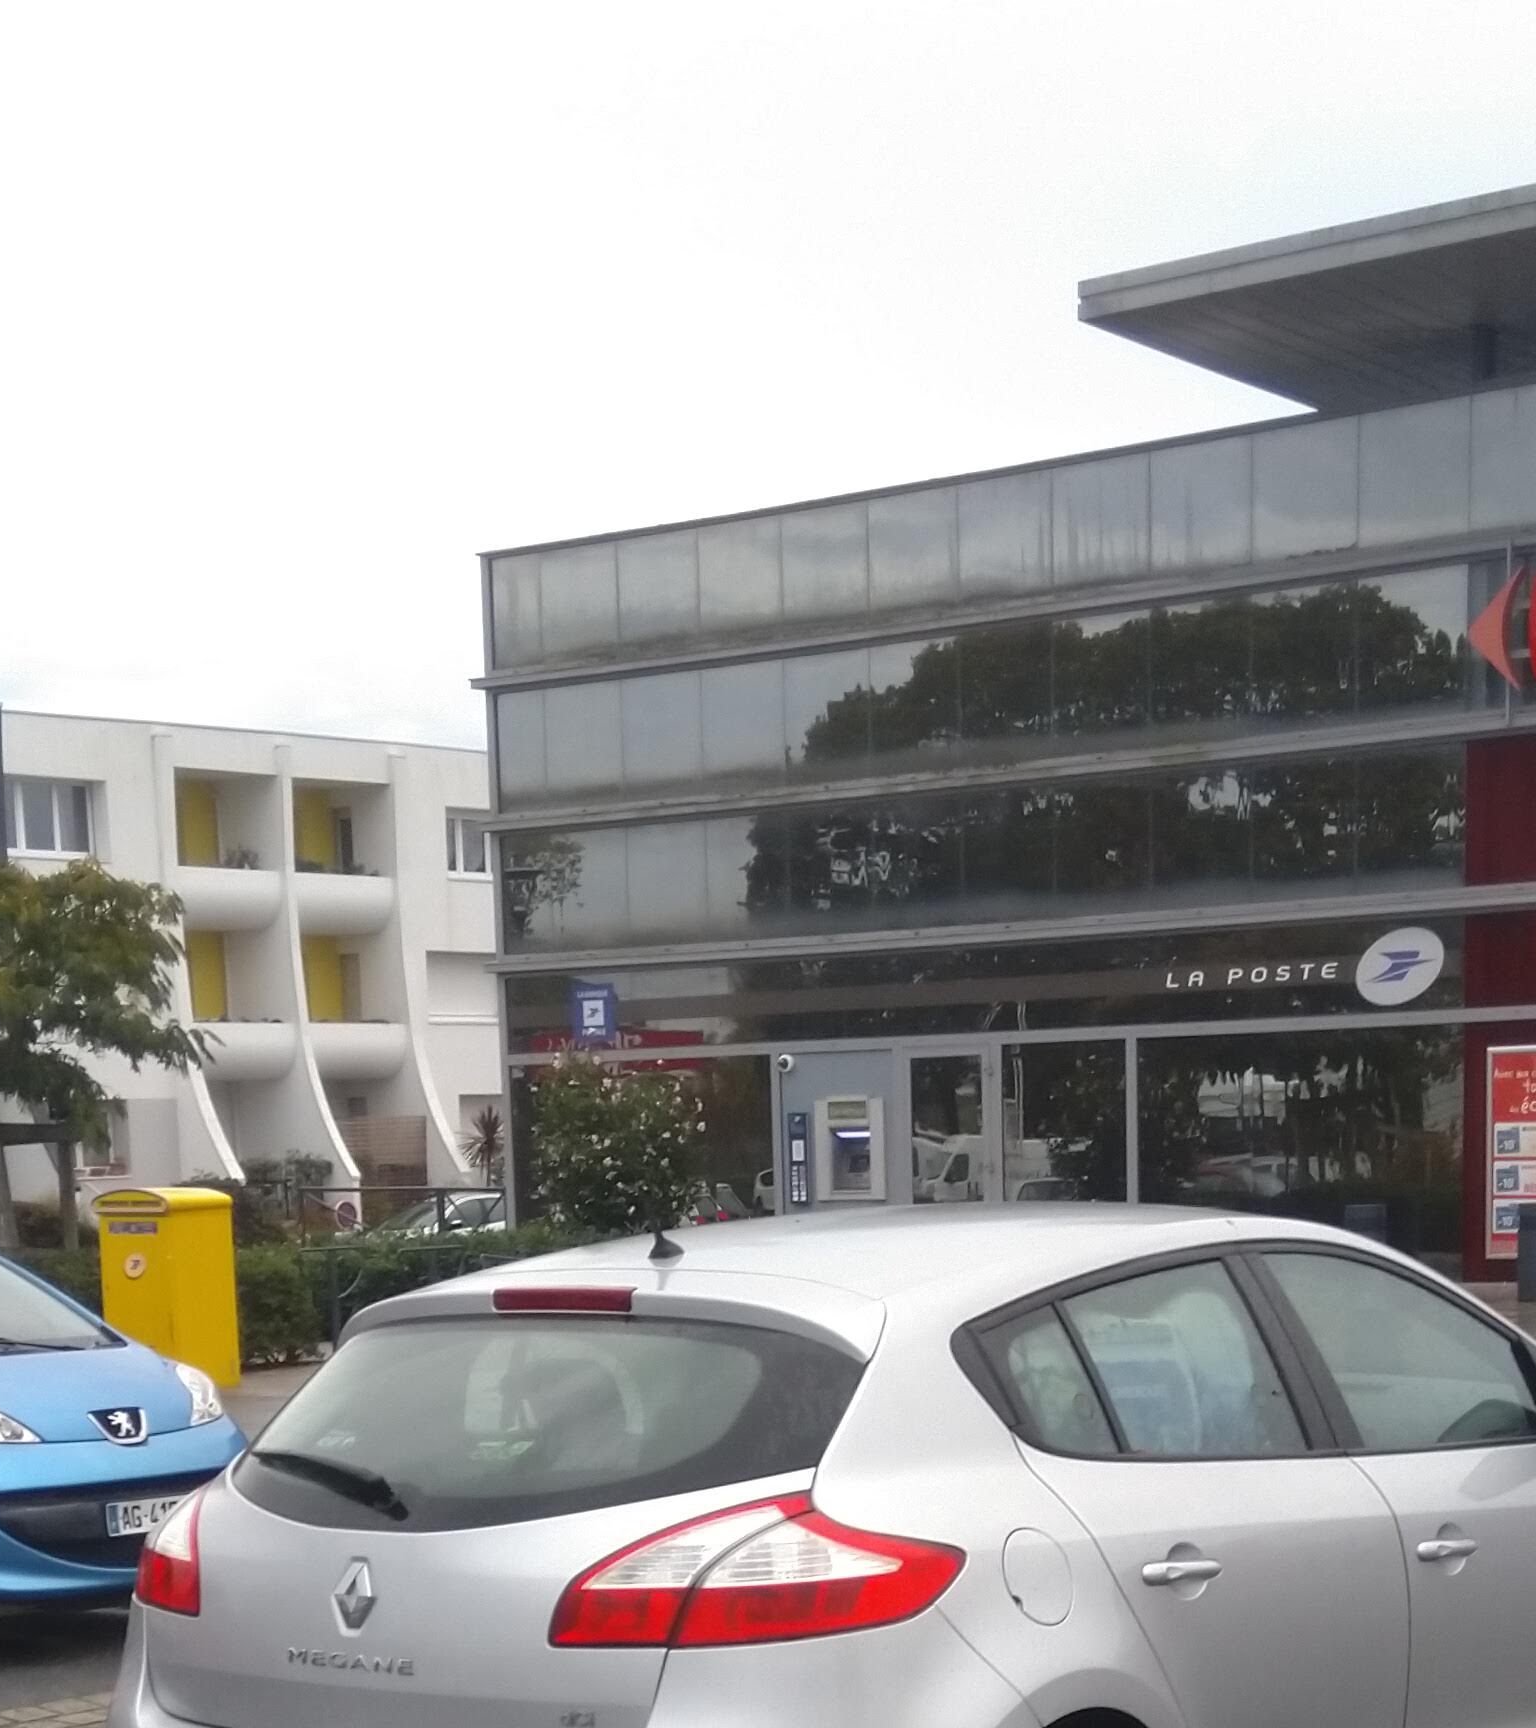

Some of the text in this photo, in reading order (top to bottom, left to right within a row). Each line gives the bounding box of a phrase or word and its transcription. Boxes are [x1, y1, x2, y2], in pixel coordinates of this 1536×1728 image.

[1166, 962, 1338, 988] LA POSTE
[288, 1647, 414, 1676] MEGANE
